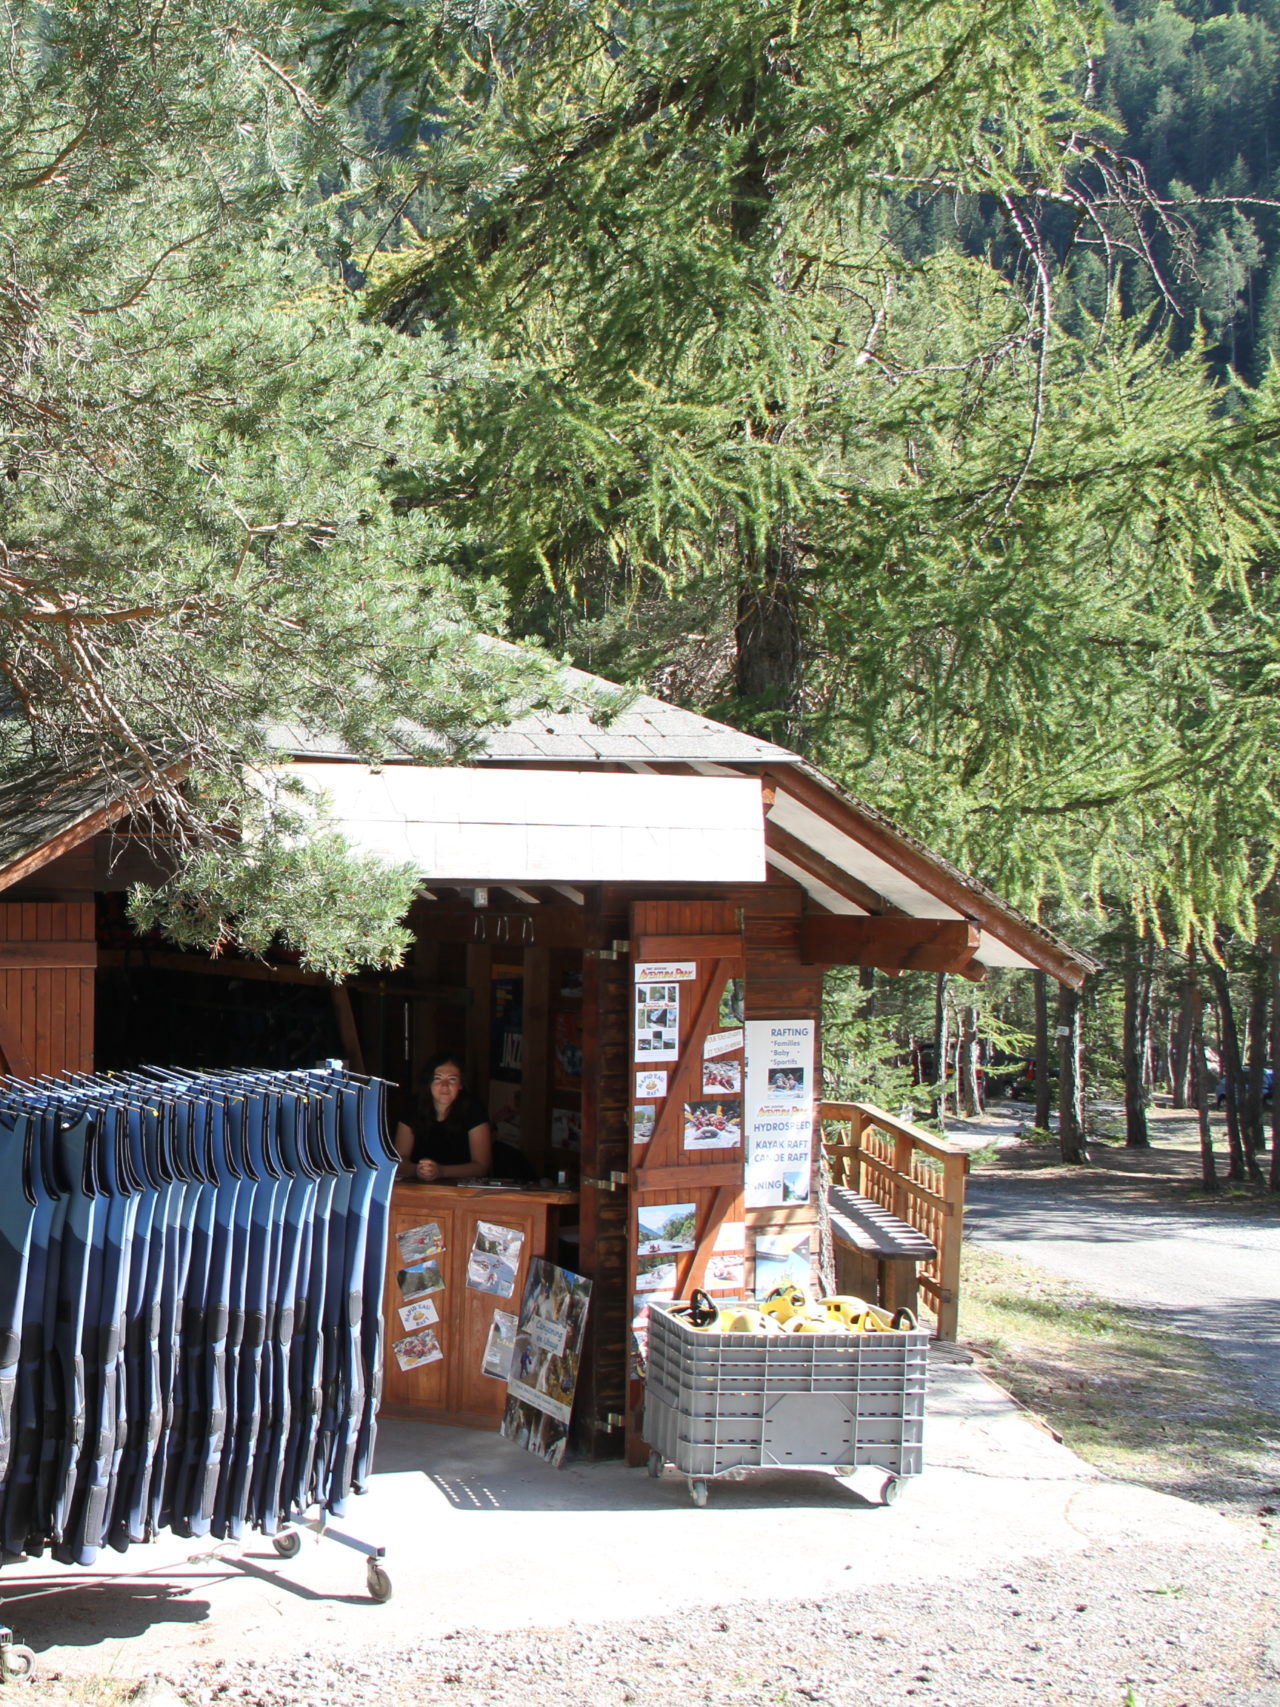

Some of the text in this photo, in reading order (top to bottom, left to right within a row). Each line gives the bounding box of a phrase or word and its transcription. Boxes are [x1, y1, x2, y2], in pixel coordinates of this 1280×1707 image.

[771, 1027, 809, 1037] RAFTING
[753, 1120, 811, 1133] HYDROSPEED
[755, 1139, 809, 1150] KAYAK RAFT
[787, 1152, 809, 1162] RAFT
